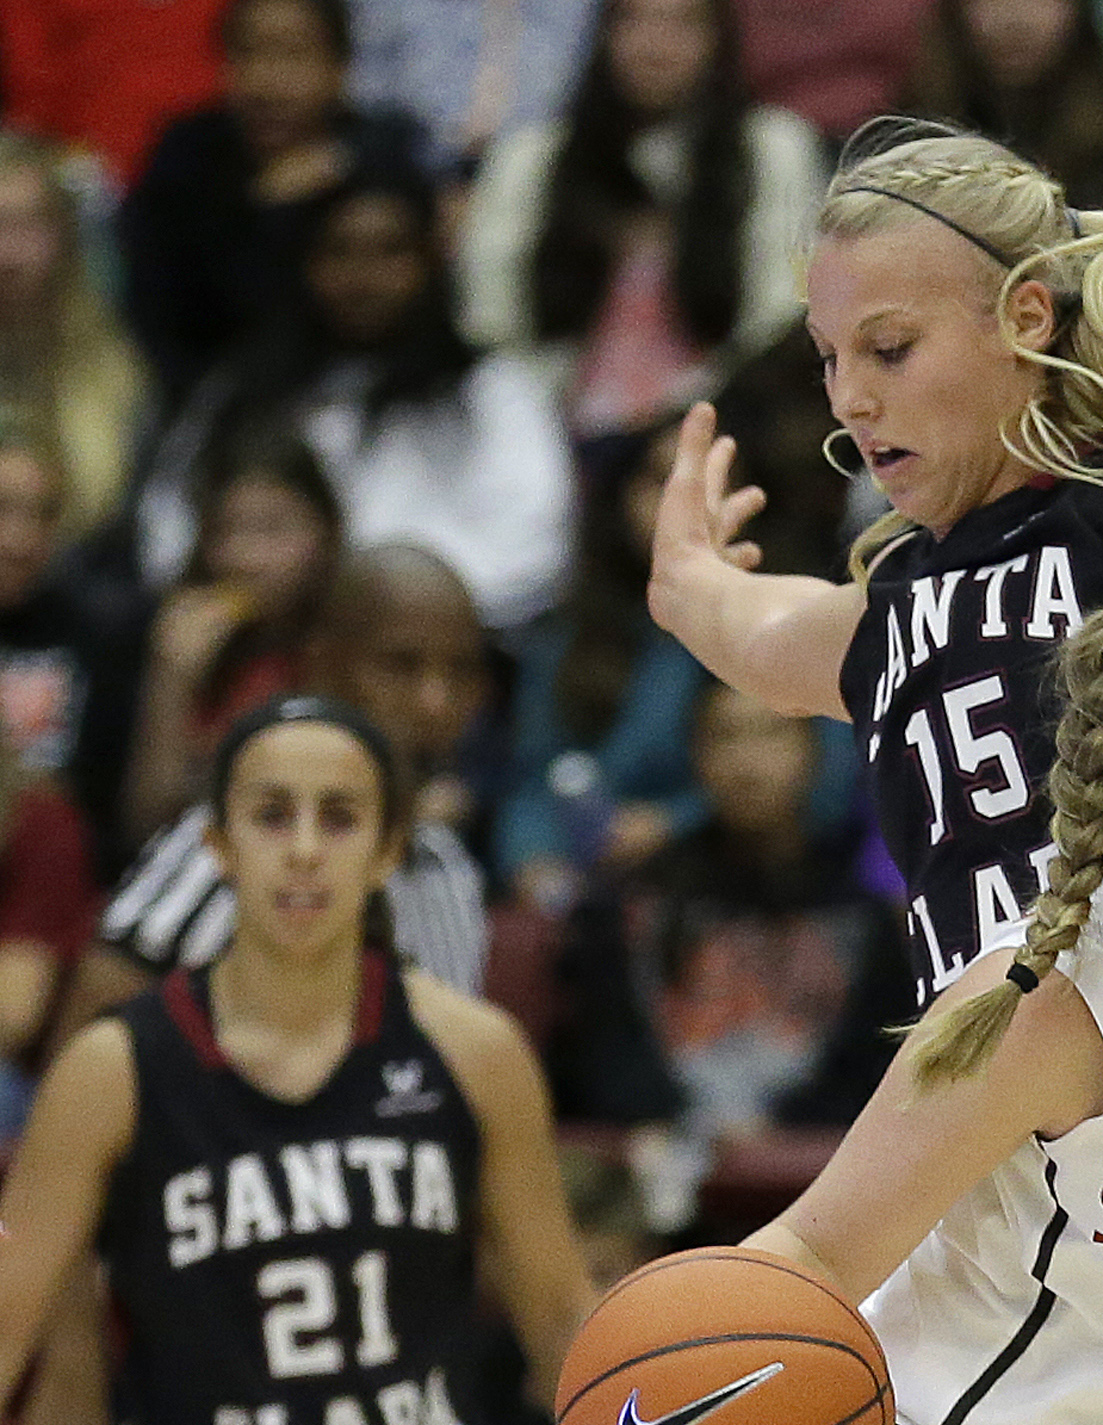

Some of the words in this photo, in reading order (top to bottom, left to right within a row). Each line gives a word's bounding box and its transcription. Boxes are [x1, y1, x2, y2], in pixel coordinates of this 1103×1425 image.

[868, 546, 1084, 763] ANTA
[904, 675, 1029, 845] 15
[162, 1136, 458, 1269] SANTA
[257, 1249, 397, 1379] 21
